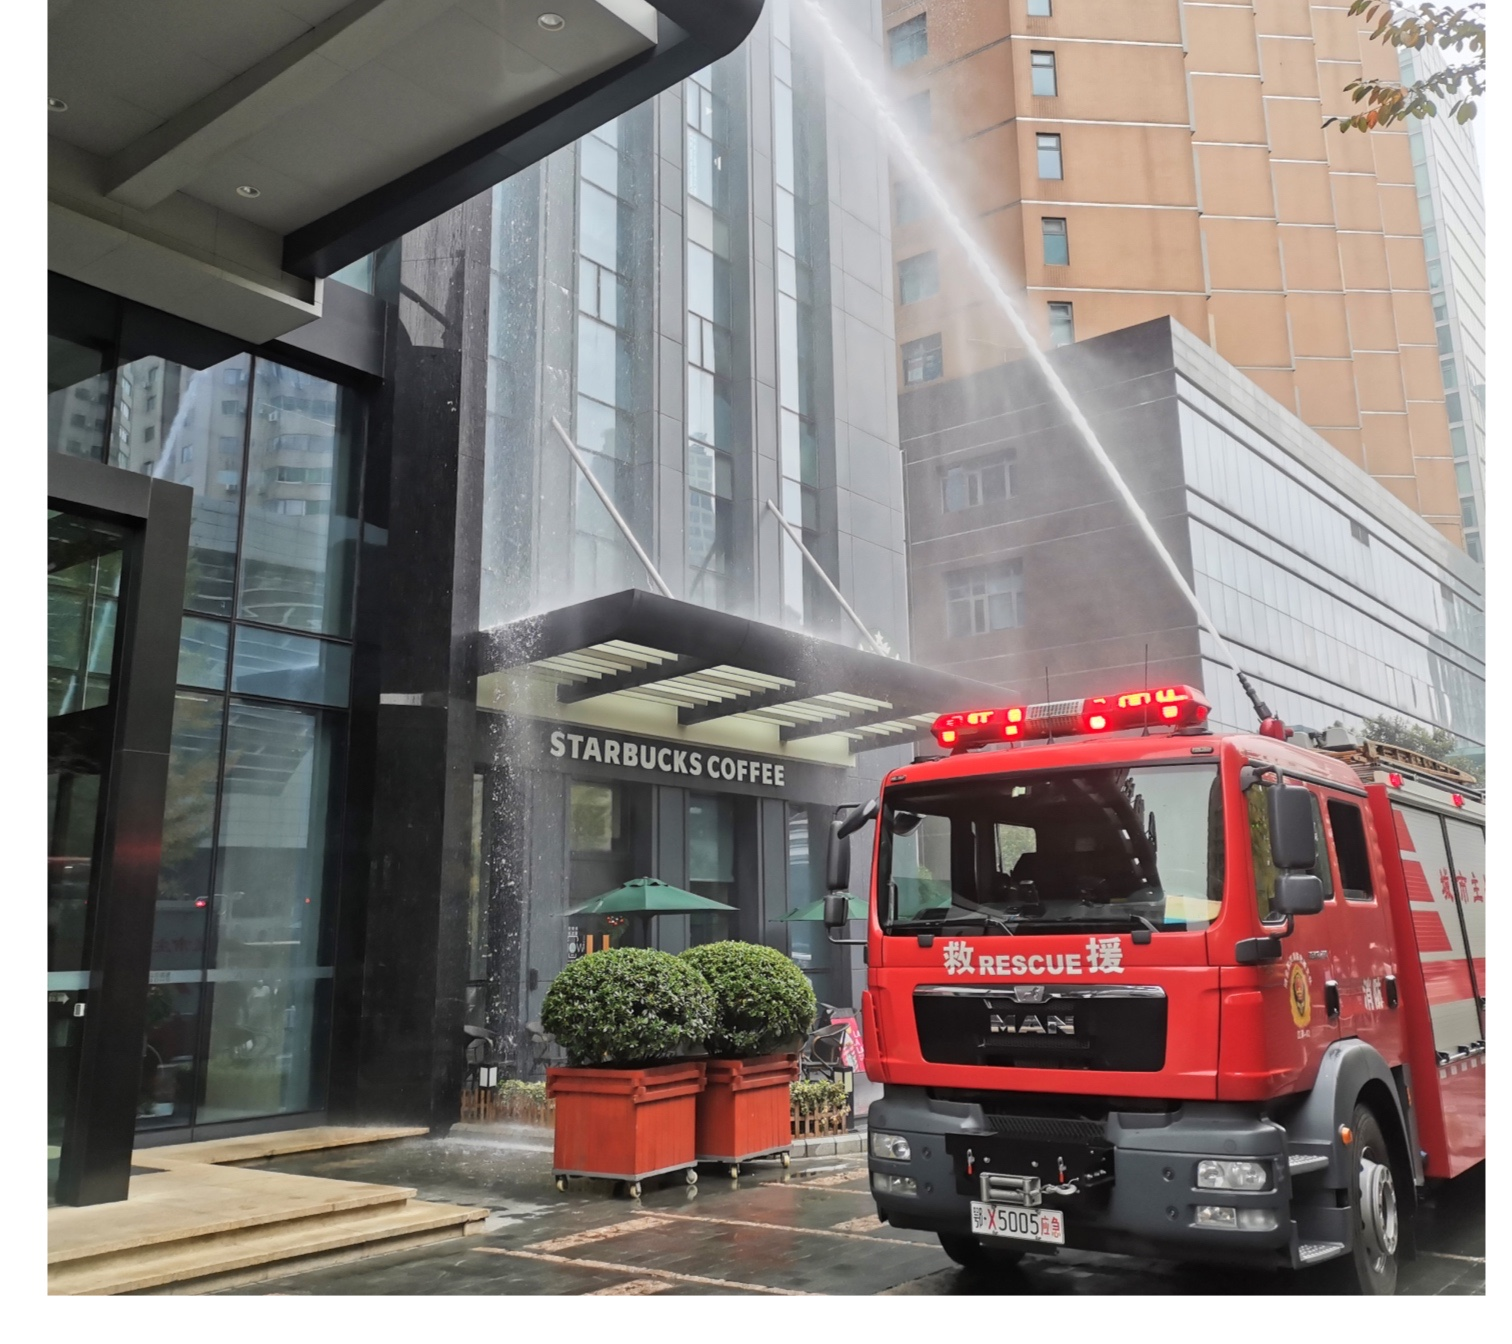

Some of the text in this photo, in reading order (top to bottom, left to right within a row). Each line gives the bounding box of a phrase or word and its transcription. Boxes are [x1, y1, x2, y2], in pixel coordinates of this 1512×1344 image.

[550, 730, 785, 787] STARBUCKS COFFEE
[1439, 867, 1486, 905] 城市主
[943, 936, 1125, 976] 救 RESCUE 援
[990, 1014, 1075, 1035] MAN
